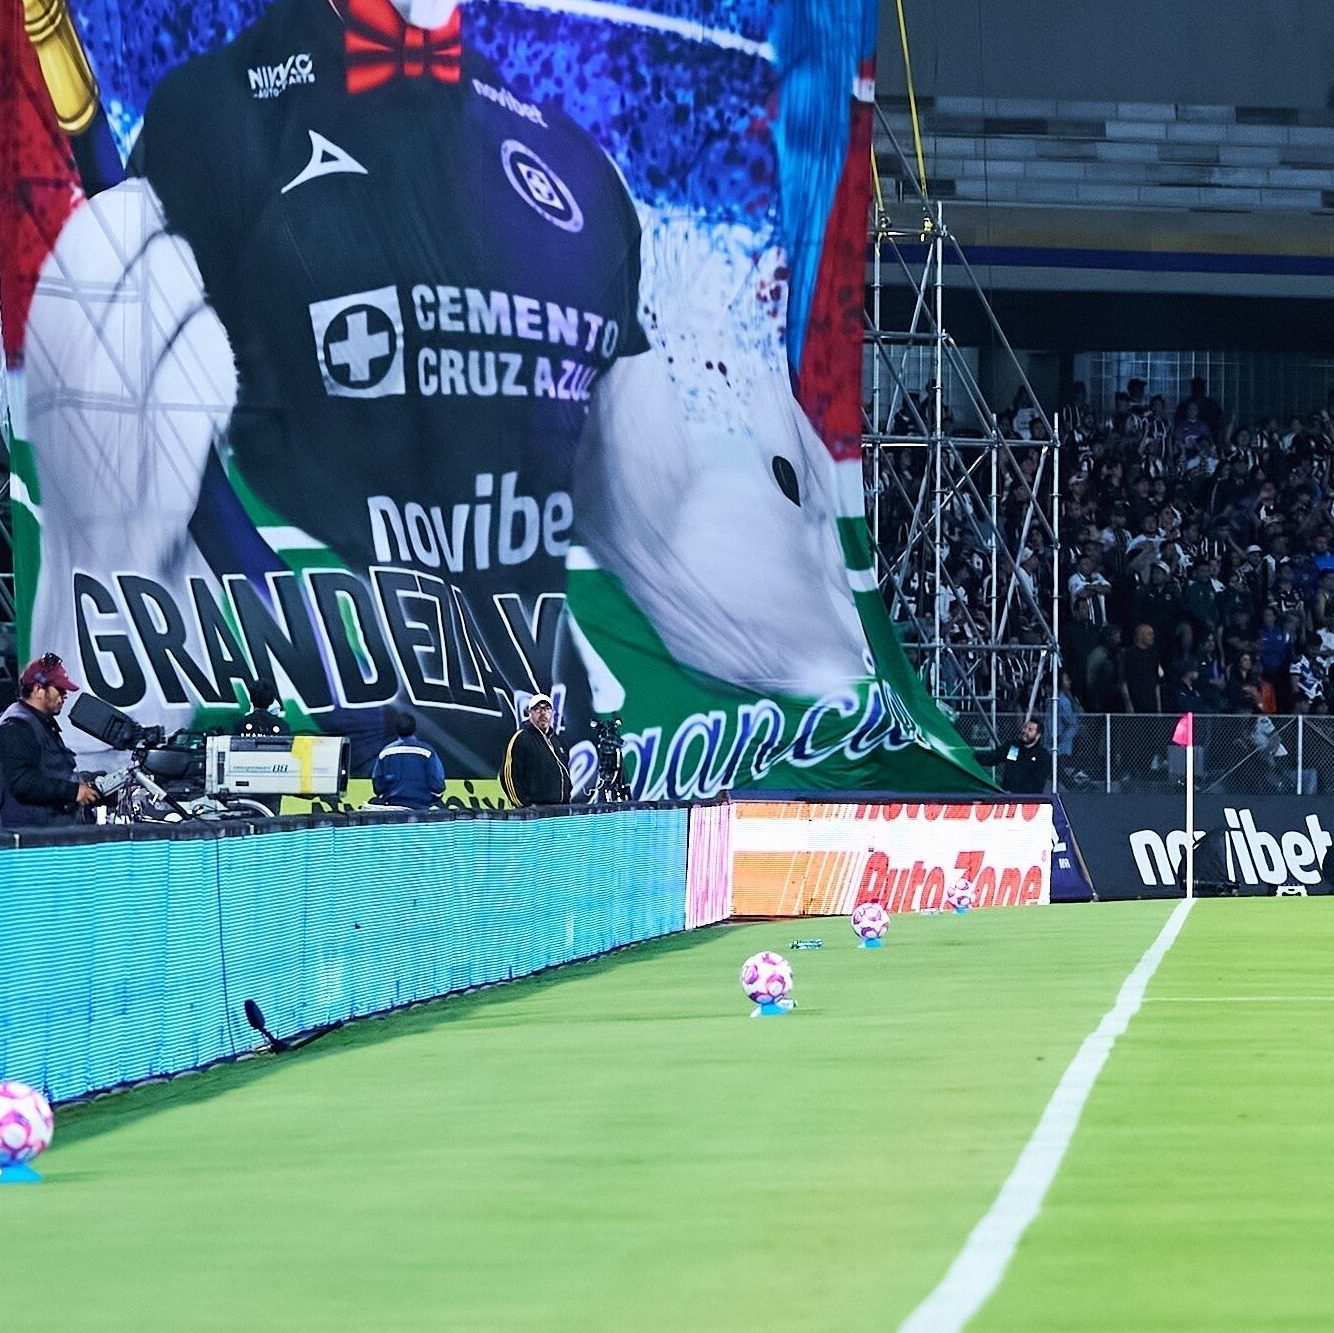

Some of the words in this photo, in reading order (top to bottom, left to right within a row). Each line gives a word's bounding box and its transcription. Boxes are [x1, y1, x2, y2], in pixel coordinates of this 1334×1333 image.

[412, 284, 619, 358] CEMENTO
[418, 347, 528, 396] CRUZ
[73, 567, 517, 718] GRANDEZA
